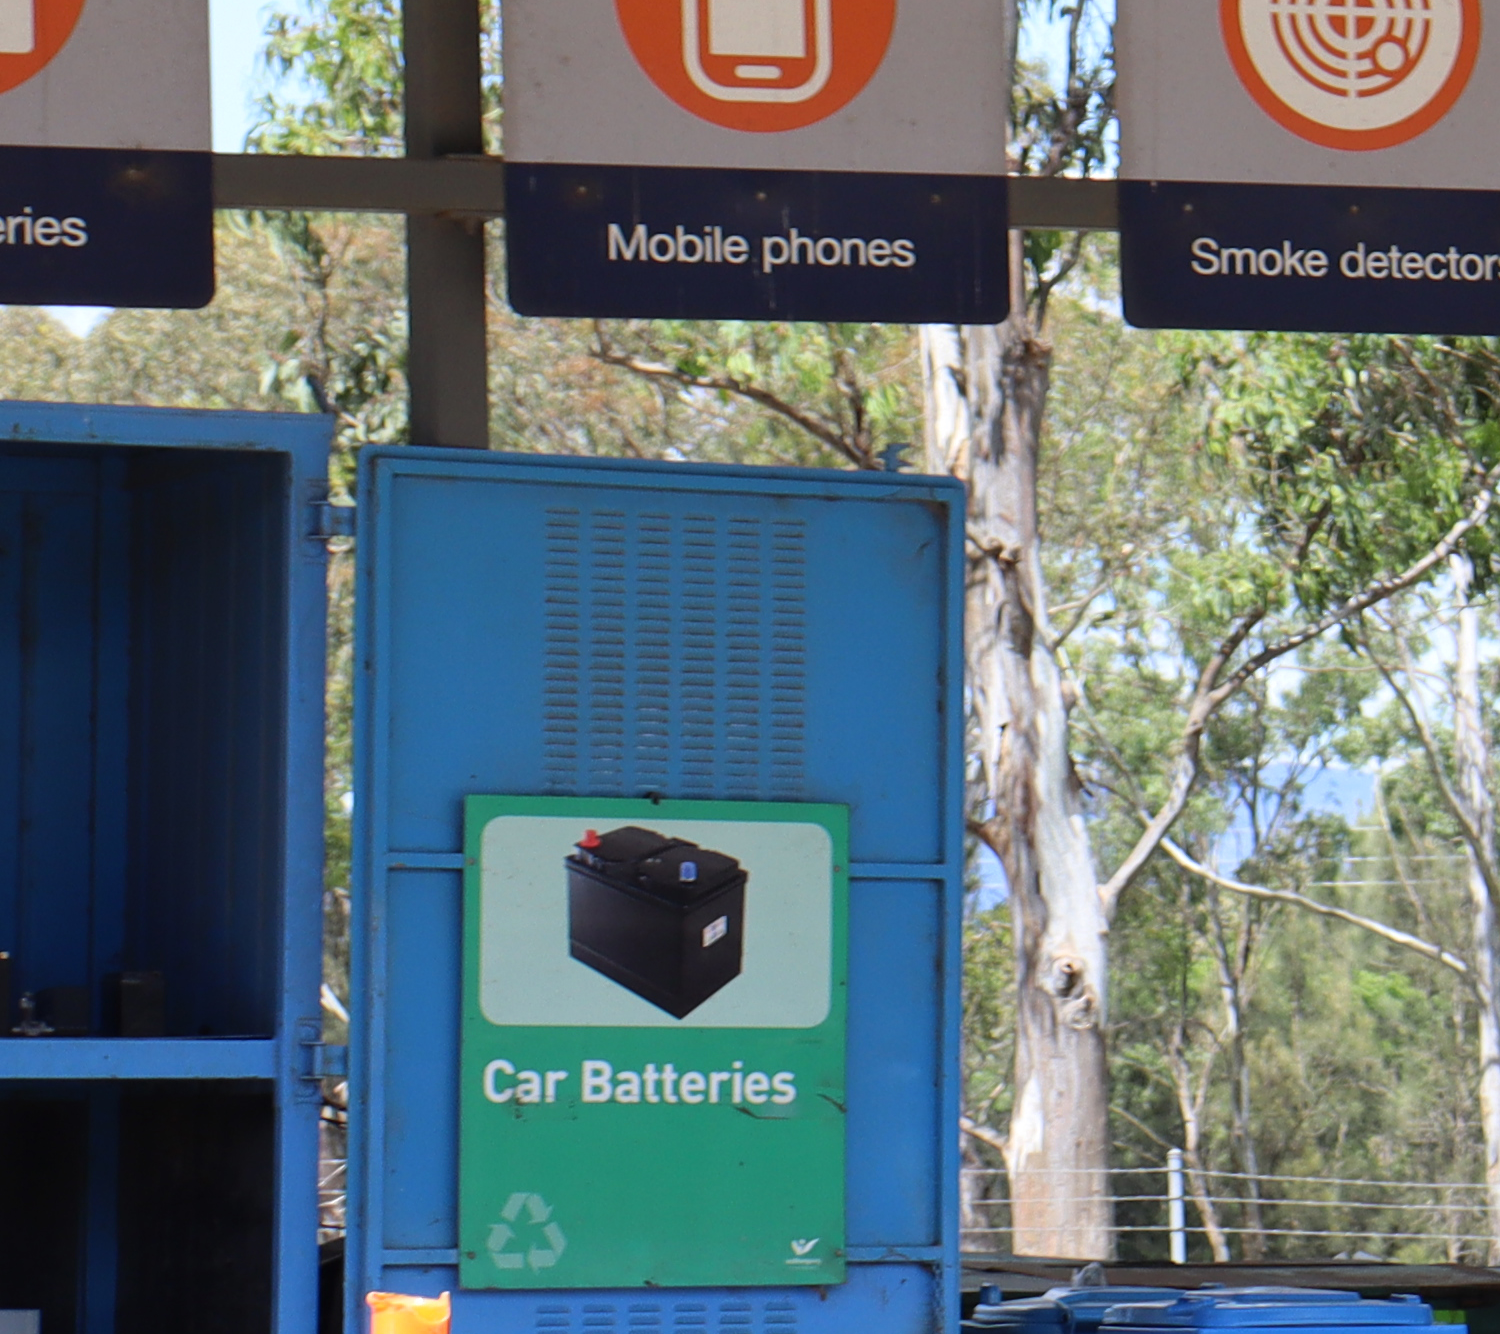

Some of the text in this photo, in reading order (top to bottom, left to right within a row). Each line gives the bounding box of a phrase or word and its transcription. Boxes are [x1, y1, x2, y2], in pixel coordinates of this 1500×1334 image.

[0, 206, 88, 247] ries
[607, 223, 916, 273] Mobile phones
[1191, 237, 1328, 277] Smoke
[483, 1059, 797, 1104] Car Batteries
